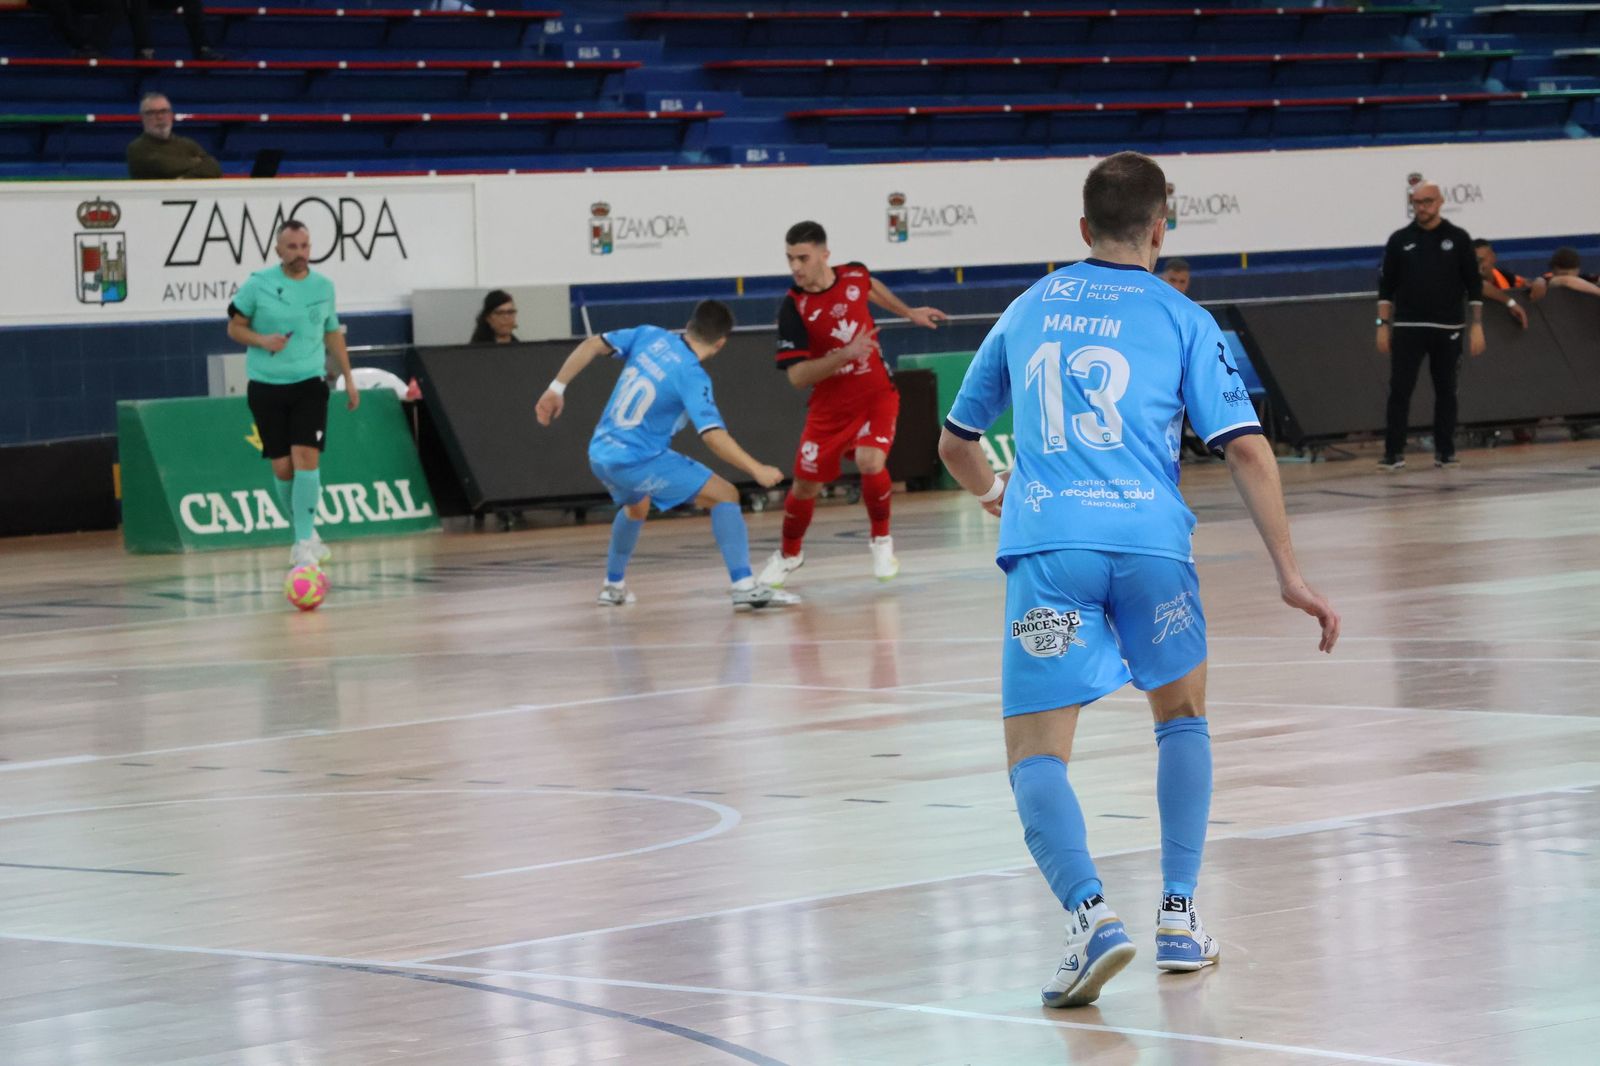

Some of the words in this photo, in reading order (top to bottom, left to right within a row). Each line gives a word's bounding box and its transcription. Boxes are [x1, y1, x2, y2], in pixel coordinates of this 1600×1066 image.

[1180, 193, 1241, 216] ZAMORA
[1444, 183, 1486, 204] MORA
[616, 215, 689, 239] ZAMORA
[911, 204, 978, 228] ZAMORA
[162, 197, 407, 266] ZAMORA
[1087, 292, 1119, 301] PLUS
[1090, 283, 1144, 294] KITCHEN
[1043, 313, 1121, 338] MARTÍN
[609, 366, 656, 431] 10
[1025, 341, 1130, 455] 13
[1060, 488, 1119, 499] recoletas
[1123, 487, 1155, 500] salud
[1072, 479, 1106, 487] CENTRO
[180, 489, 289, 534] CAJA
[317, 479, 432, 525] URAL
[1081, 499, 1137, 509] CAMPOAMOR
[1012, 611, 1080, 638] BROCENSE
[1034, 634, 1058, 652] 22
